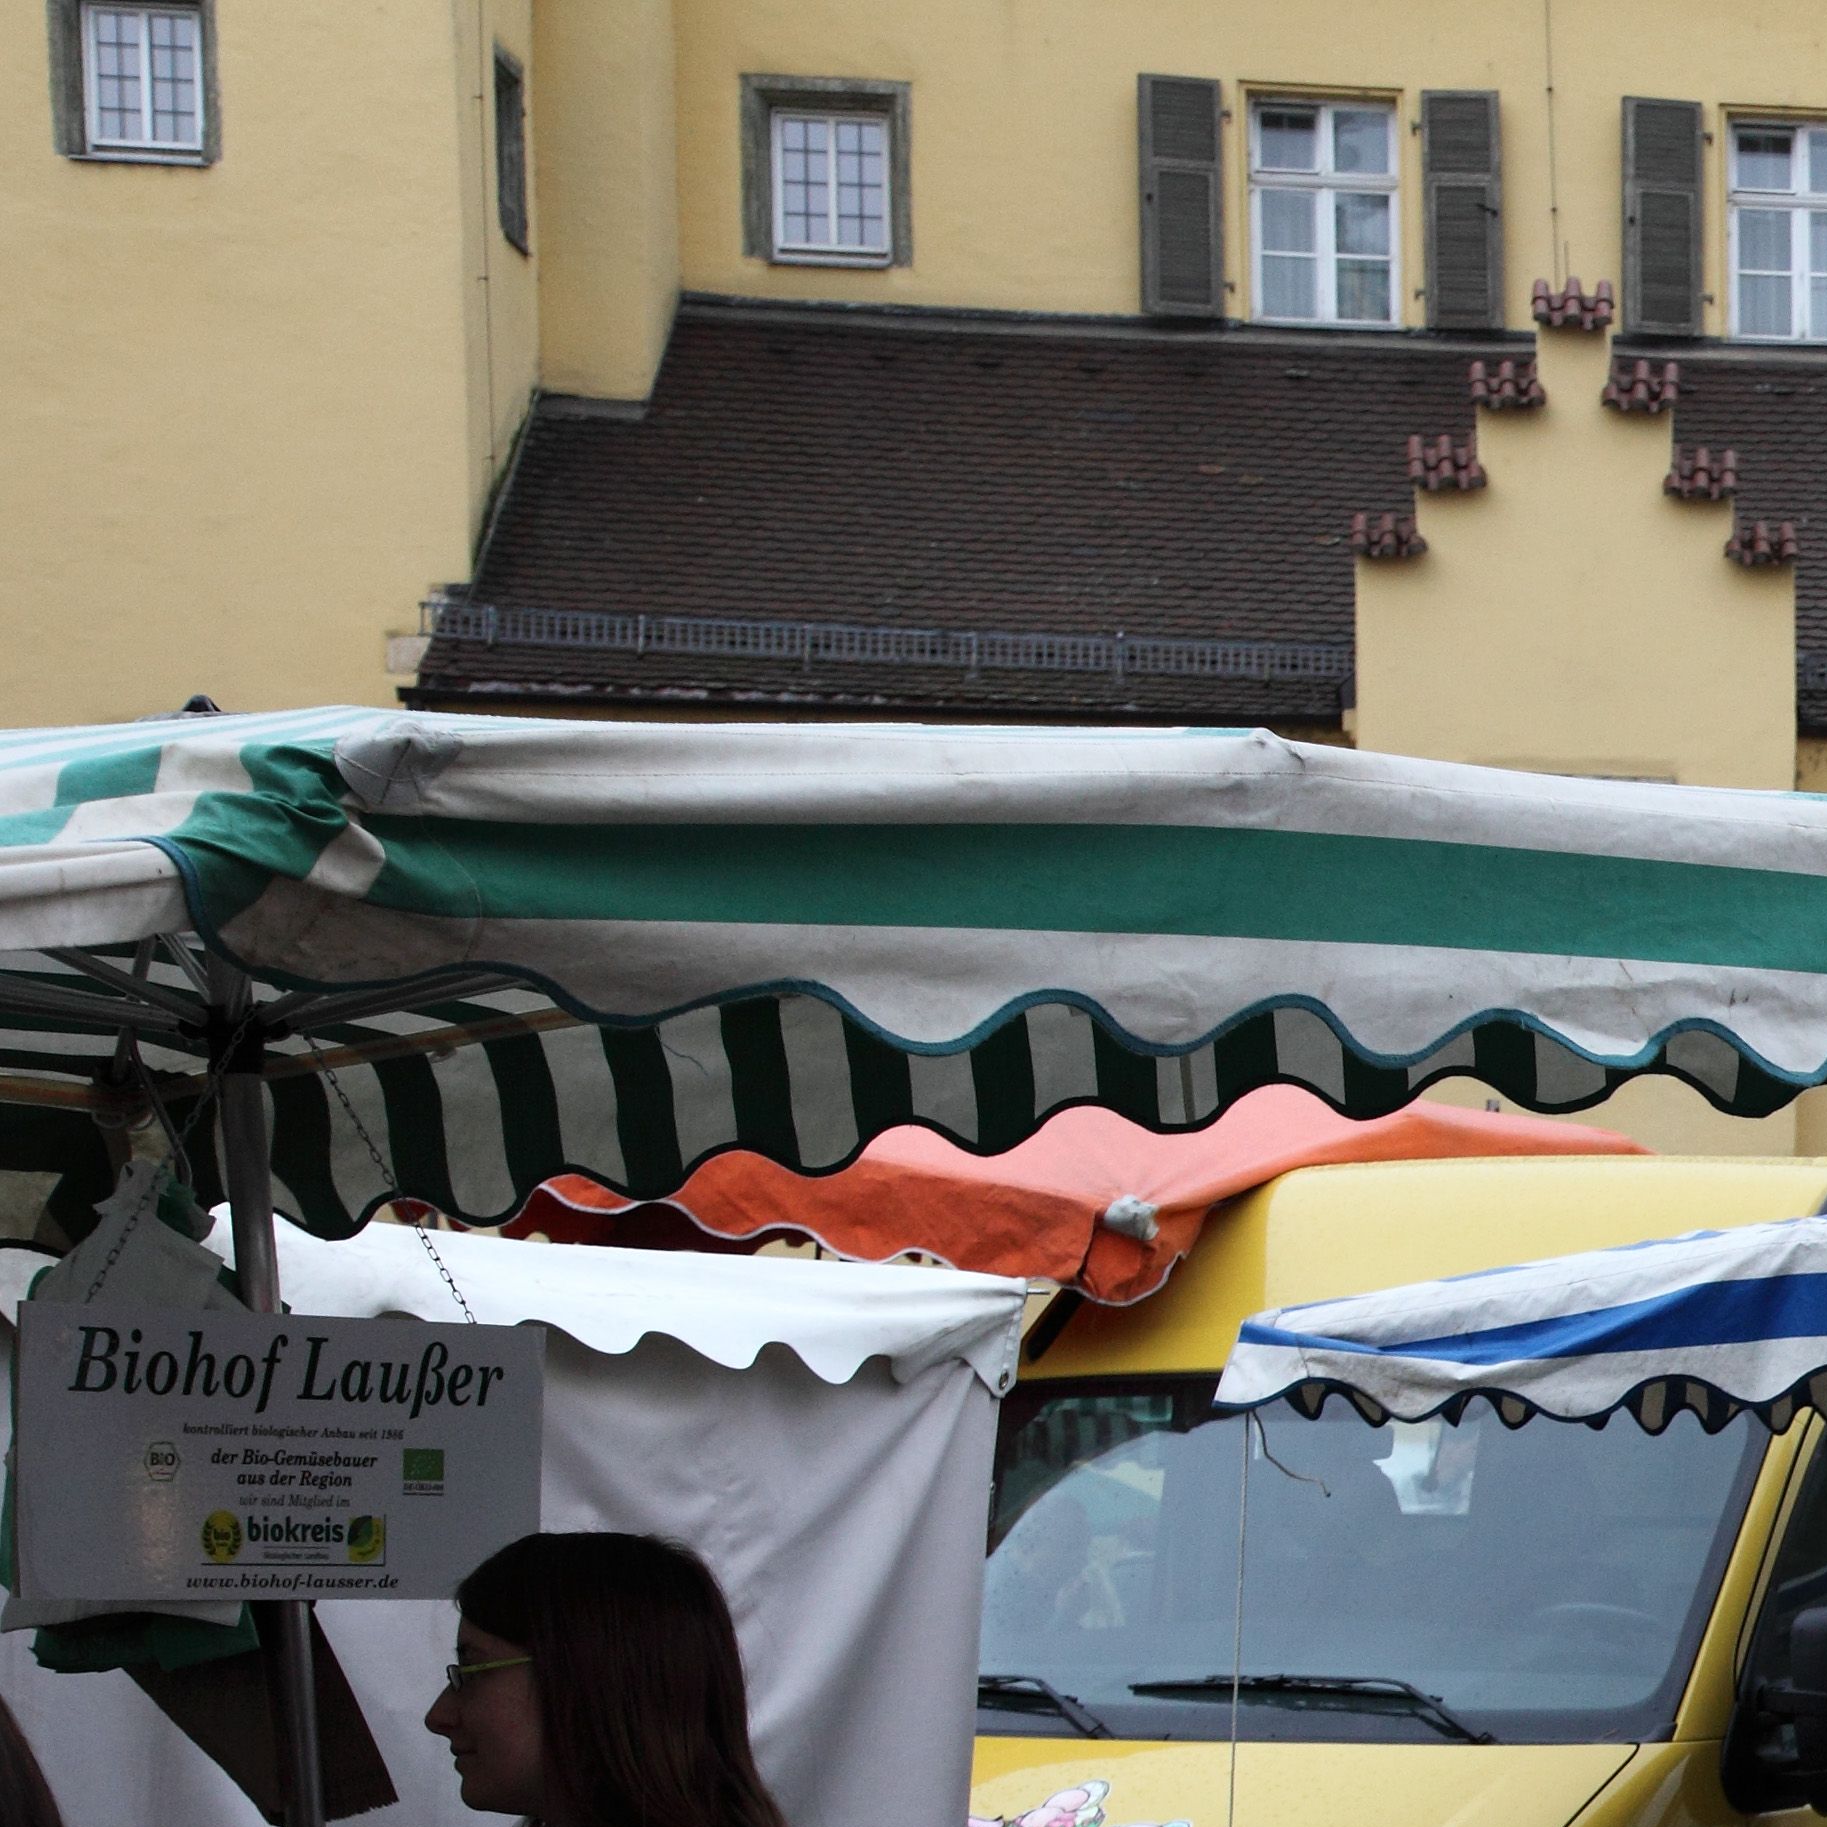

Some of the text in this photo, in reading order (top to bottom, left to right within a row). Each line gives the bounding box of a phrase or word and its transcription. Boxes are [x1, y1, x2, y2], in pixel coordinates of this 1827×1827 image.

[68, 1326, 505, 1420] Biohof Laußer
[183, 1423, 249, 1436] kontrolliert
[251, 1425, 318, 1439] biologischer
[321, 1428, 356, 1439] Anbau
[211, 1449, 379, 1468] der Bio-Gemüsebauer
[237, 1471, 353, 1490] aus der Region
[239, 1496, 259, 1507] wir
[261, 1494, 284, 1507] sind
[288, 1495, 333, 1510] Mitglied
[247, 1515, 344, 1543] biokreis
[186, 1574, 399, 1590] www.biohof-lausser.de
